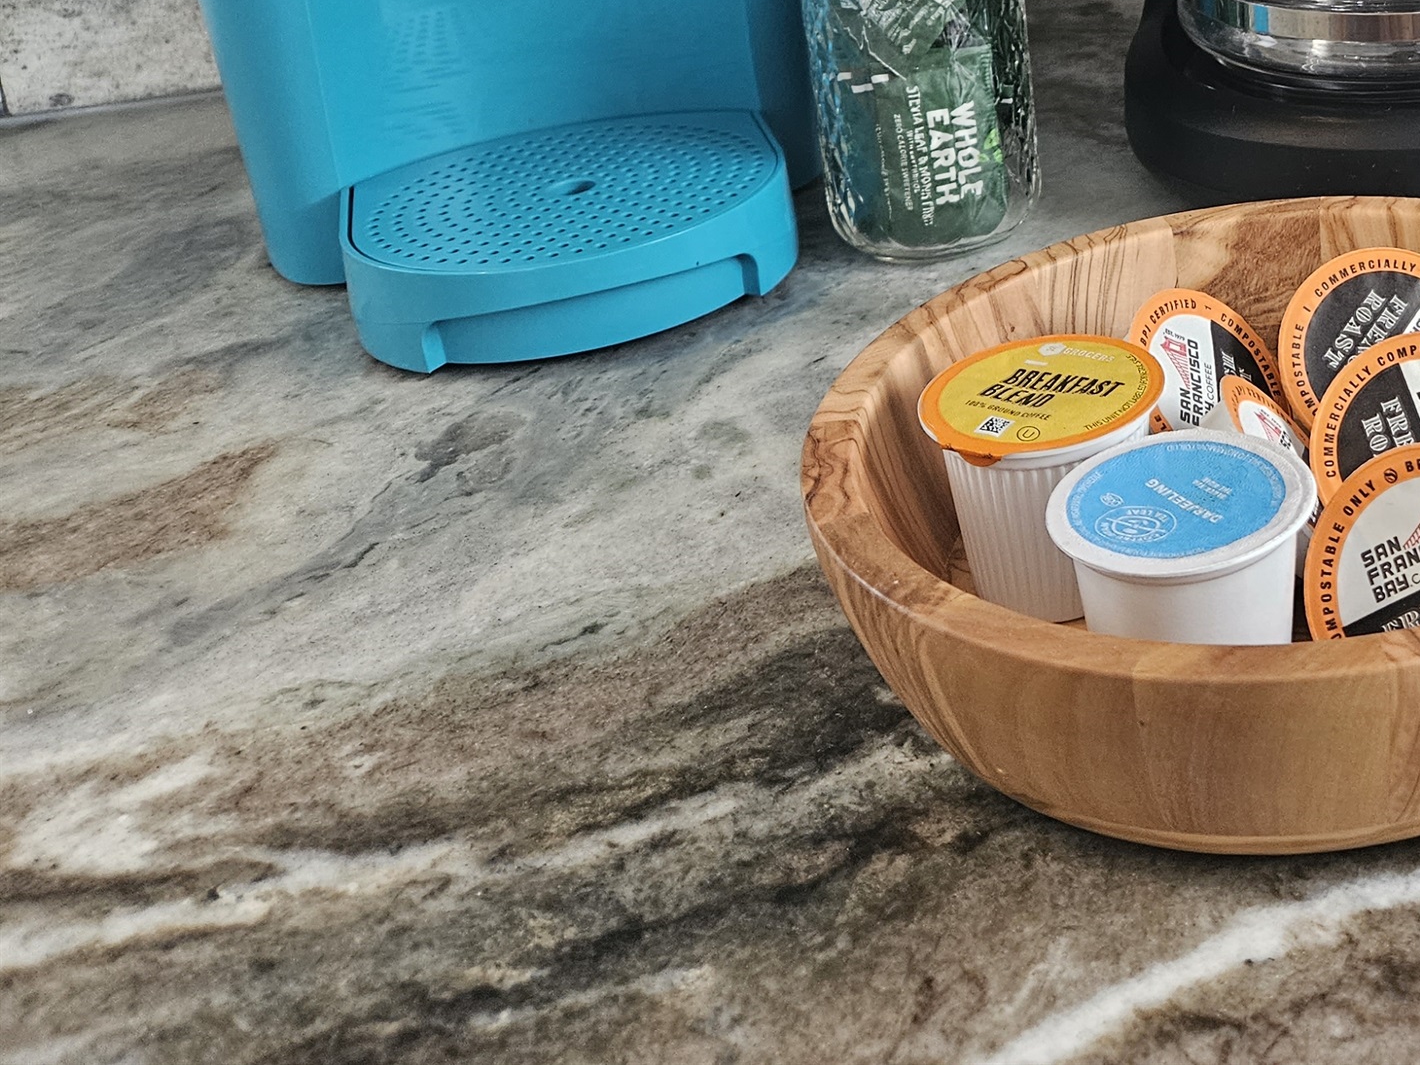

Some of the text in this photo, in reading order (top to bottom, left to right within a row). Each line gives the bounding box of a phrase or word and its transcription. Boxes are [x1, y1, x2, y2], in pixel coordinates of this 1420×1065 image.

[906, 85, 923, 125] STEVIA
[894, 114, 903, 133] ZERO
[914, 126, 927, 153] LEAF
[897, 135, 907, 166] CALORIE
[926, 108, 961, 205] EARTH
[950, 100, 983, 199] WHOLE
[1314, 259, 1416, 298] COMMERCIALLY
[1323, 289, 1386, 369] ROAST
[1064, 347, 1115, 362] GROCERS
[1140, 298, 1281, 397] BPI CERTIFIED COMPOSTABLE
[979, 384, 1055, 408] BLEND
[1001, 368, 1125, 397] BREAKFAST
[1188, 339, 1200, 426] FRANCISCO
[965, 399, 1052, 421] 100% GROUND COFFEE
[1180, 388, 1190, 423] SAN
[1324, 365, 1372, 477] COMMERCIALLY
[1145, 478, 1224, 524] DARJEELING
[1343, 480, 1376, 516] ONLY
[1361, 536, 1402, 567] SAN
